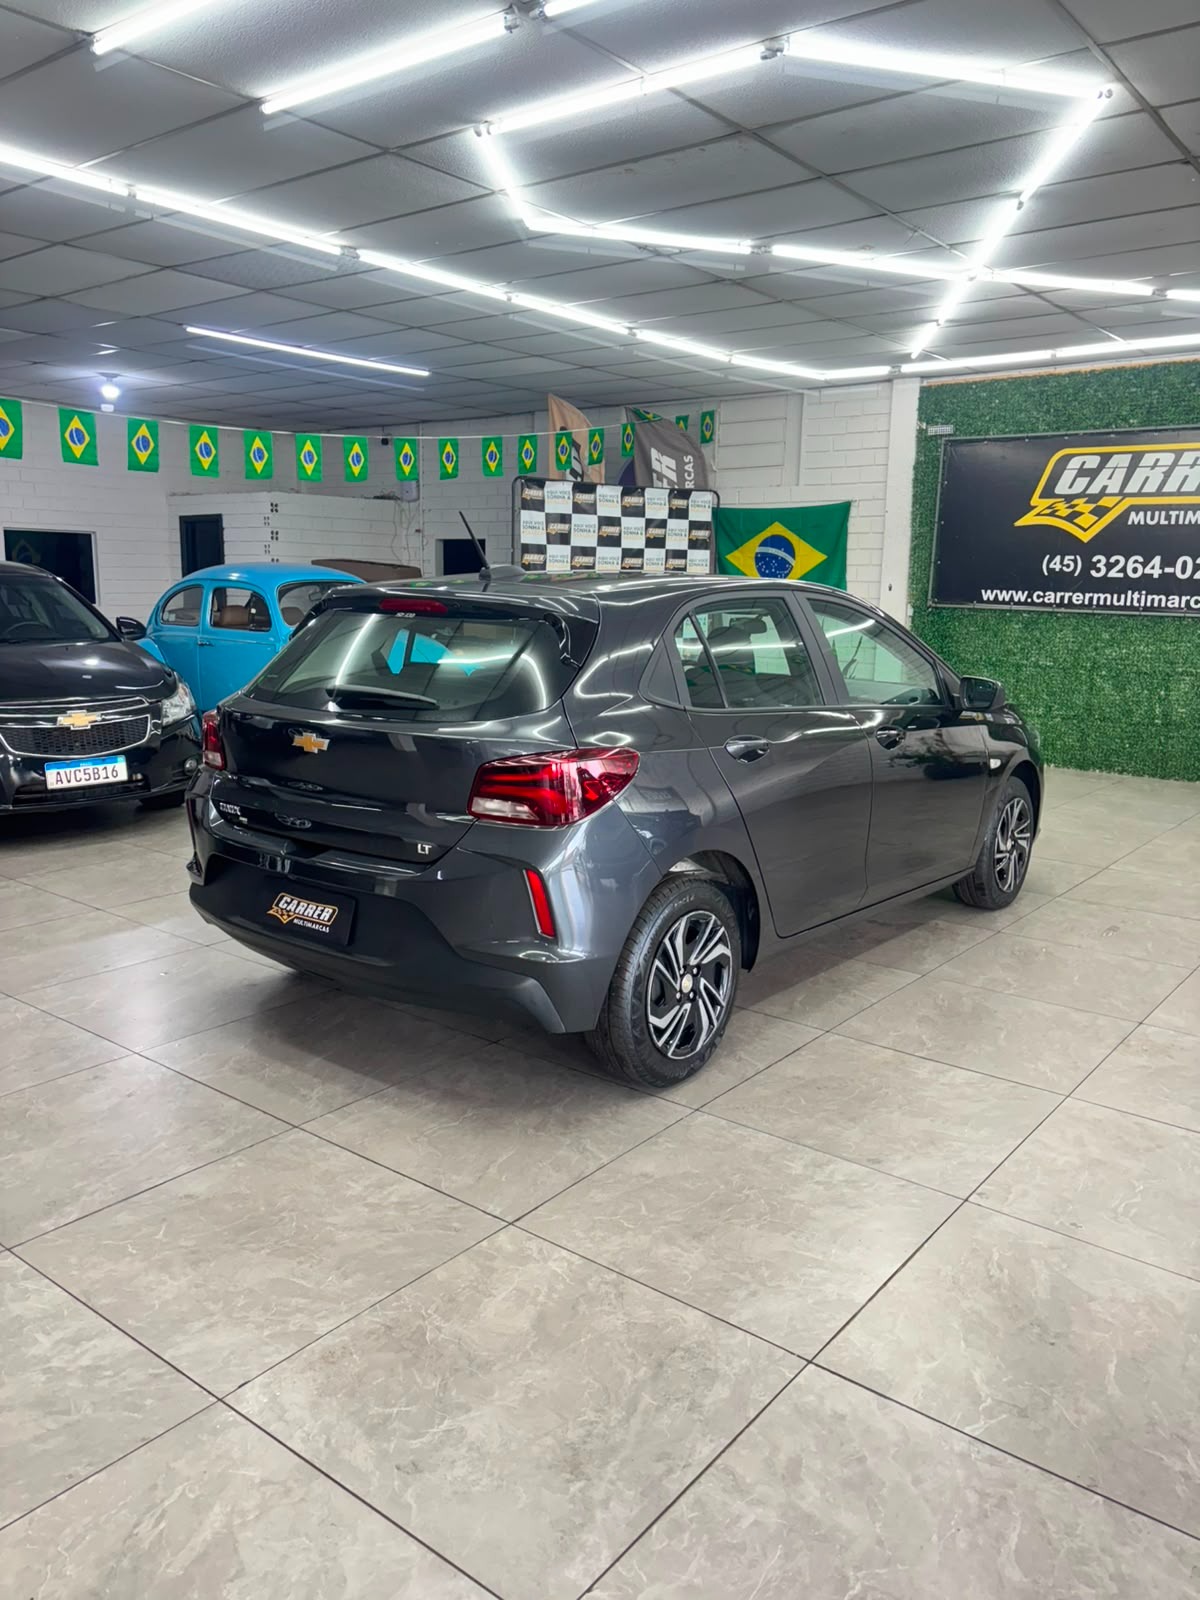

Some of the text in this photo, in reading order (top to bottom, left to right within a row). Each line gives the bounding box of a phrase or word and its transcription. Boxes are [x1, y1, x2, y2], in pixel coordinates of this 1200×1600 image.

[1055, 451, 1200, 495] CARR
[1042, 555, 1082, 576] (45)
[981, 588, 1200, 609] www.carrermultimarc
[55, 765, 119, 785] AVC5B16
[417, 843, 432, 855] LT
[278, 896, 333, 922] CARRER
[292, 918, 330, 933] MULTIMARCAS
